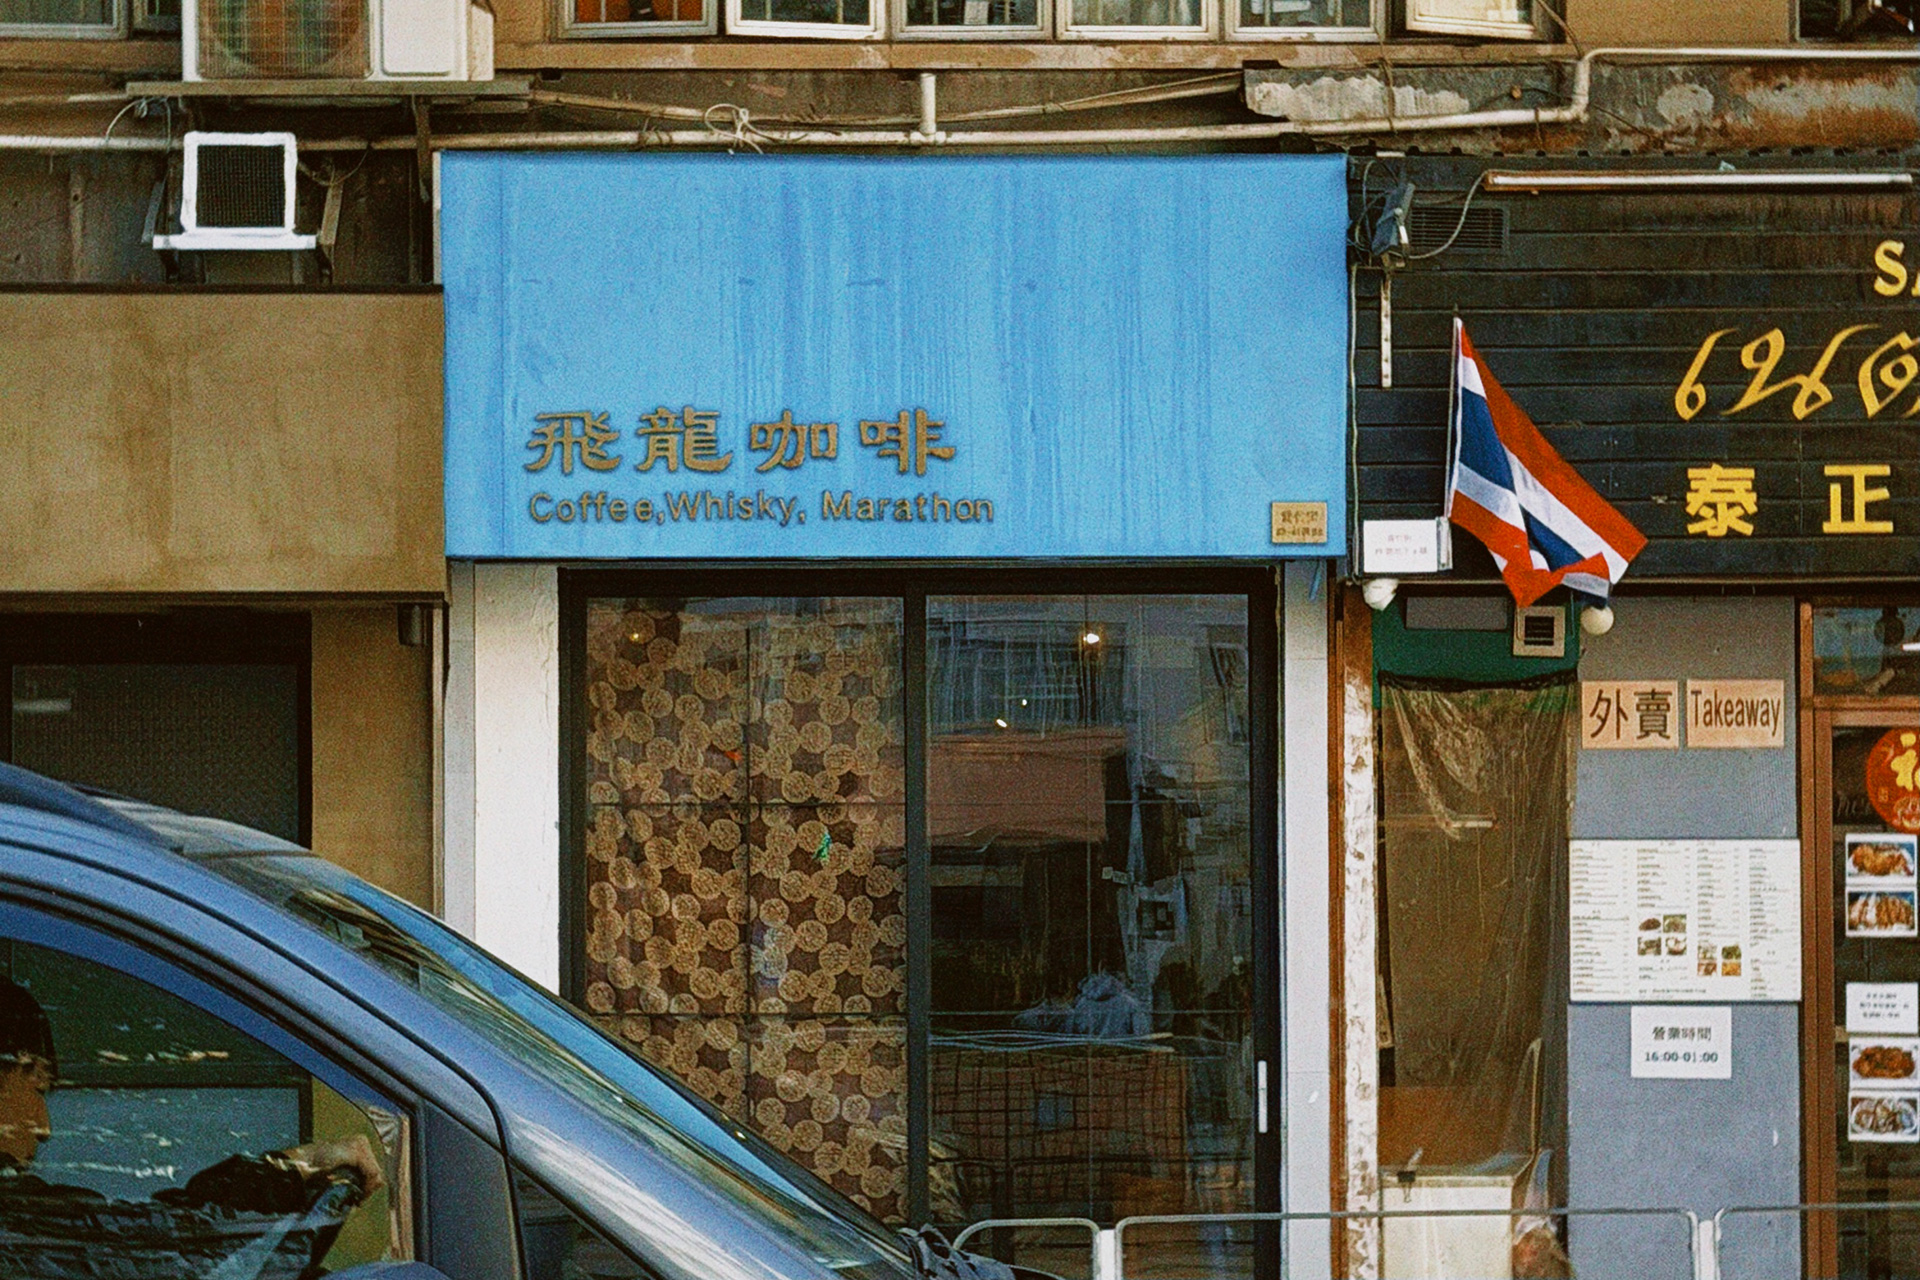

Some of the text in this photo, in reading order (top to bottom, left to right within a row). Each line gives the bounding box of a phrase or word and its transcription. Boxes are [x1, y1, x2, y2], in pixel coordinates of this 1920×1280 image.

[1873, 239, 1920, 297] S
[524, 405, 956, 476] 飛龍咖啡
[821, 489, 994, 523] Marathon
[1589, 687, 1673, 741] 外賣
[1690, 688, 1781, 738] Takeaway
[1652, 1026, 1712, 1041] 營業時間
